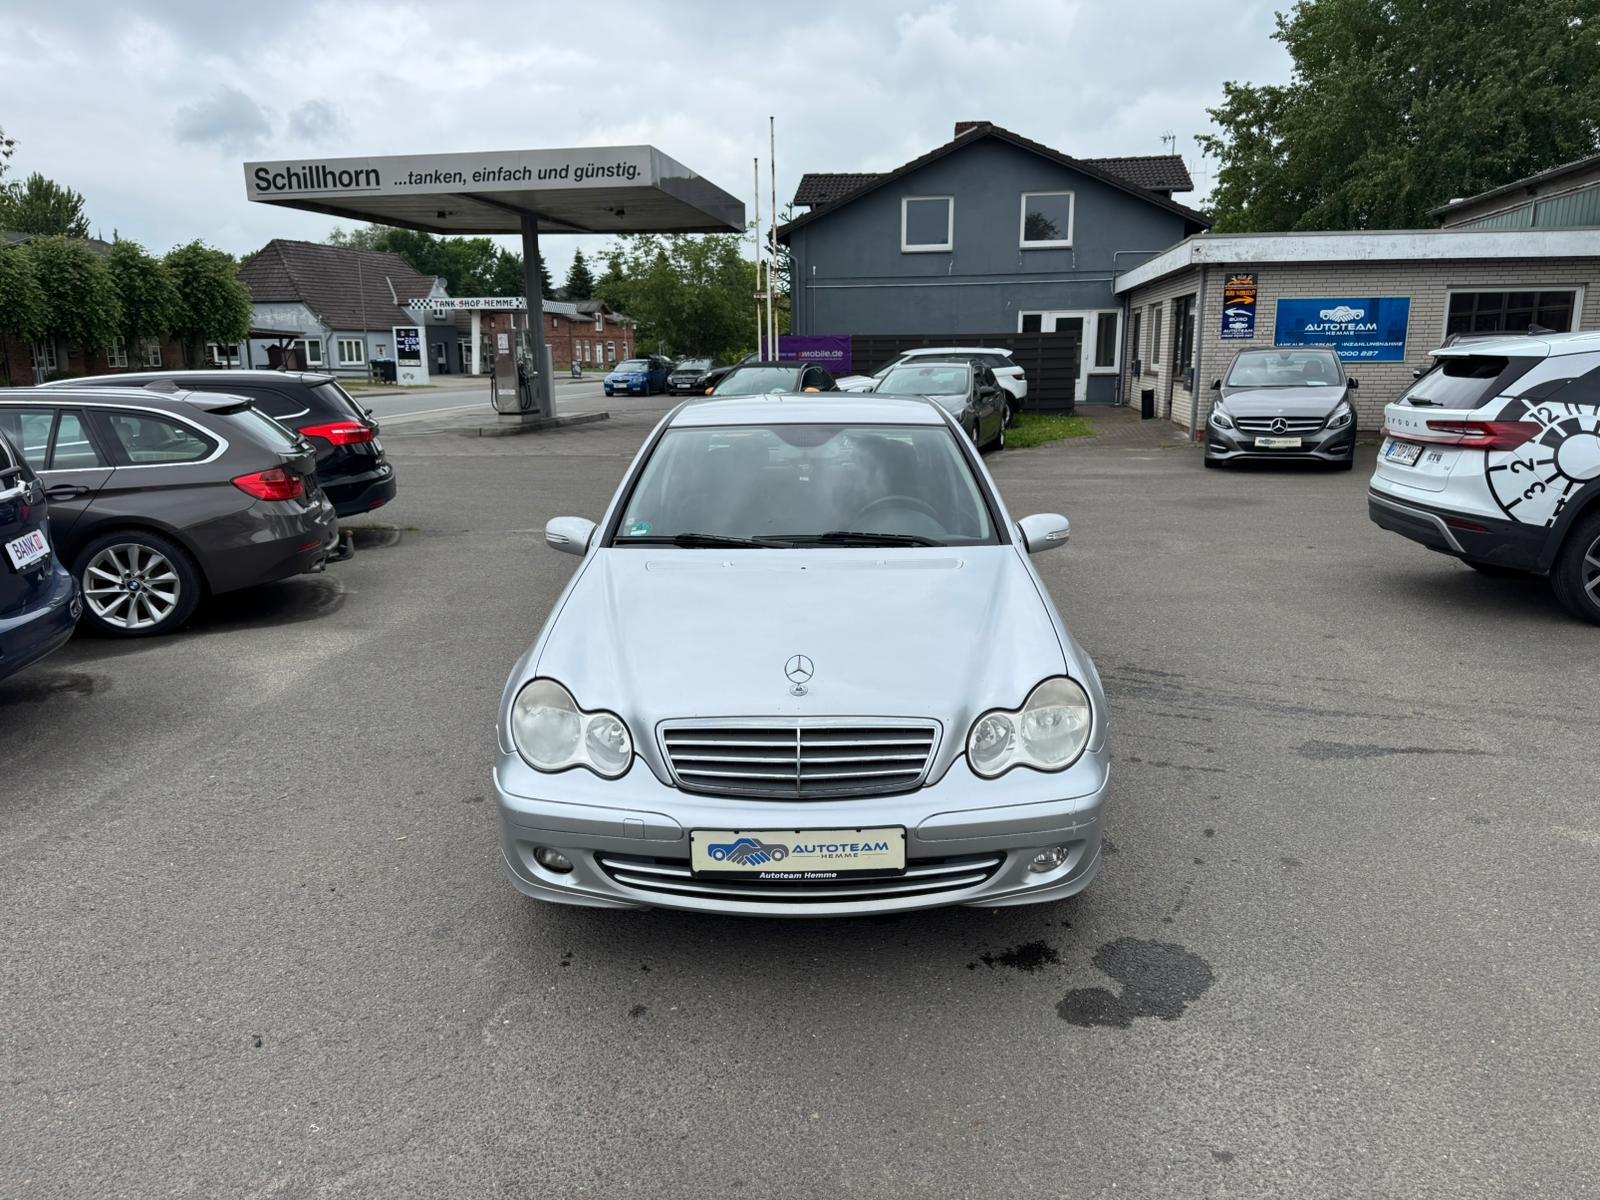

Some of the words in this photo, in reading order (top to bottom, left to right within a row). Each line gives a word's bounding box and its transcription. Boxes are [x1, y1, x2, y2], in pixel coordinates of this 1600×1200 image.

[254, 165, 381, 191] Schillhorn
[394, 169, 467, 186] ...tanken,
[472, 166, 532, 182] einfach
[538, 164, 569, 180] und
[574, 161, 641, 182] günstig.
[1304, 323, 1377, 331] AUTOTEAM
[799, 350, 843, 358] mobile.de
[1528, 407, 1560, 428] 12
[1510, 458, 1535, 474] 2
[1523, 481, 1546, 500] 3
[792, 841, 889, 853] AUTOTEAM
[759, 871, 802, 879] Autoteam
